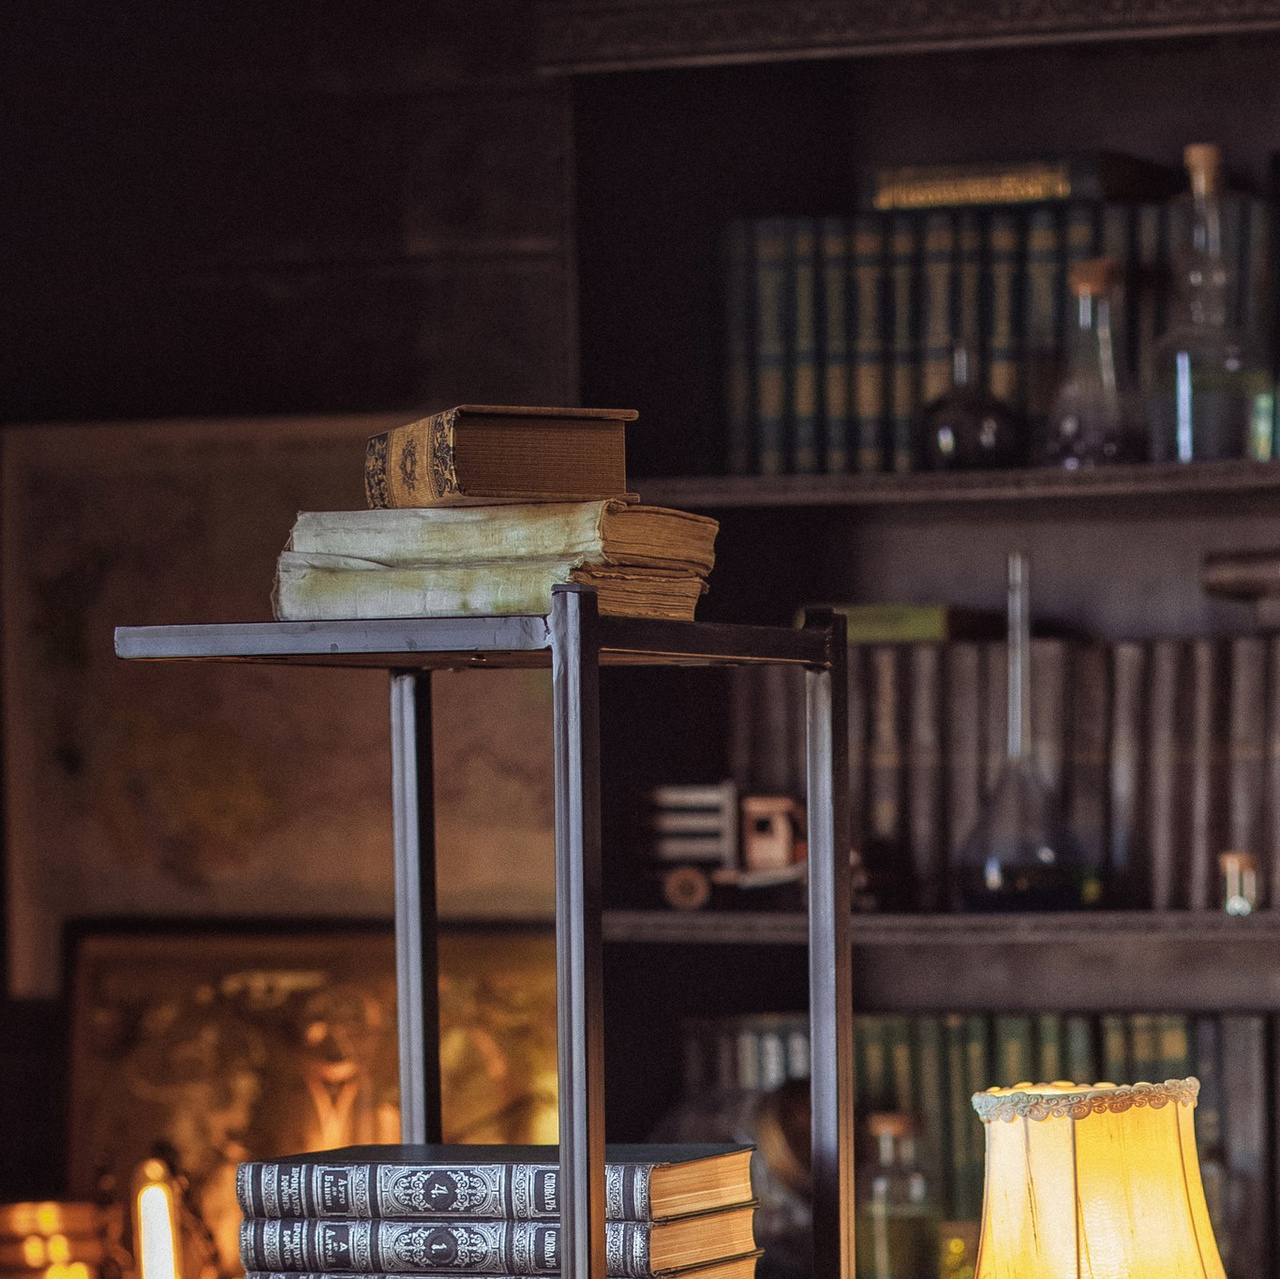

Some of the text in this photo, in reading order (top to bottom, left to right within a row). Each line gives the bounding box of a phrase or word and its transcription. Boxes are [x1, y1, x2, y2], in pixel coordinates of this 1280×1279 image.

[324, 1174, 333, 1207] Банки
[545, 1173, 557, 1211] СЛОВАРЬ
[325, 1229, 334, 1263] Алтай
[545, 1231, 557, 1268] СЛОВАРЬ
